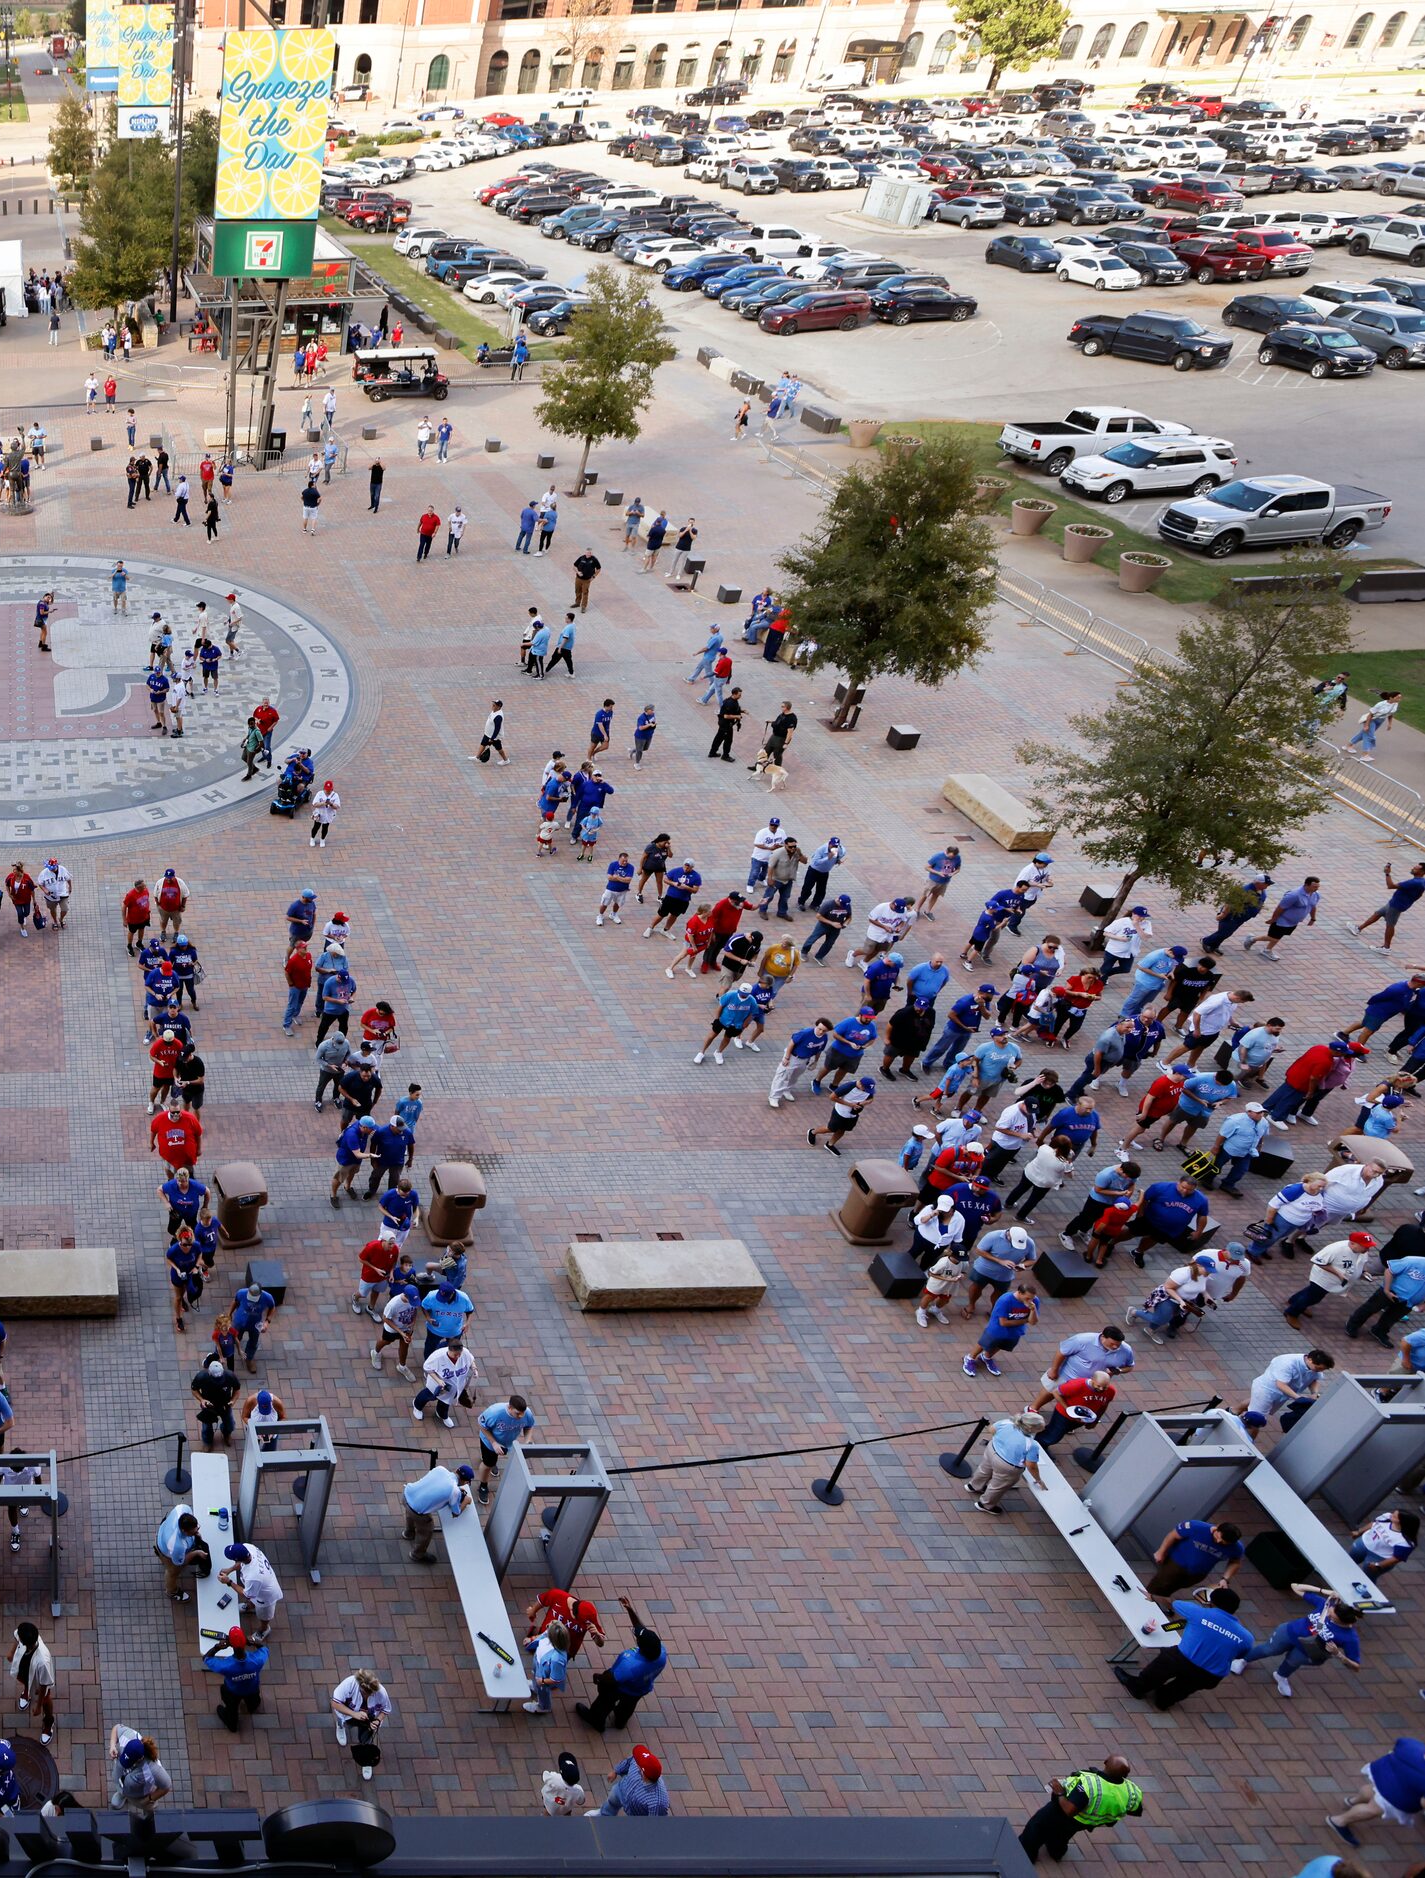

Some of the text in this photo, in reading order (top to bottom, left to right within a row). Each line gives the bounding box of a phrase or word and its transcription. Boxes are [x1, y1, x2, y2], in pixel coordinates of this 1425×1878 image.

[122, 26, 173, 48] Squeeze
[133, 46, 155, 61] the
[227, 70, 328, 116] Squeeze
[248, 107, 291, 137] the
[960, 1200, 990, 1212] TEXAS
[207, 1232, 216, 1242] T
[1200, 1617, 1244, 1643] SECURITY
